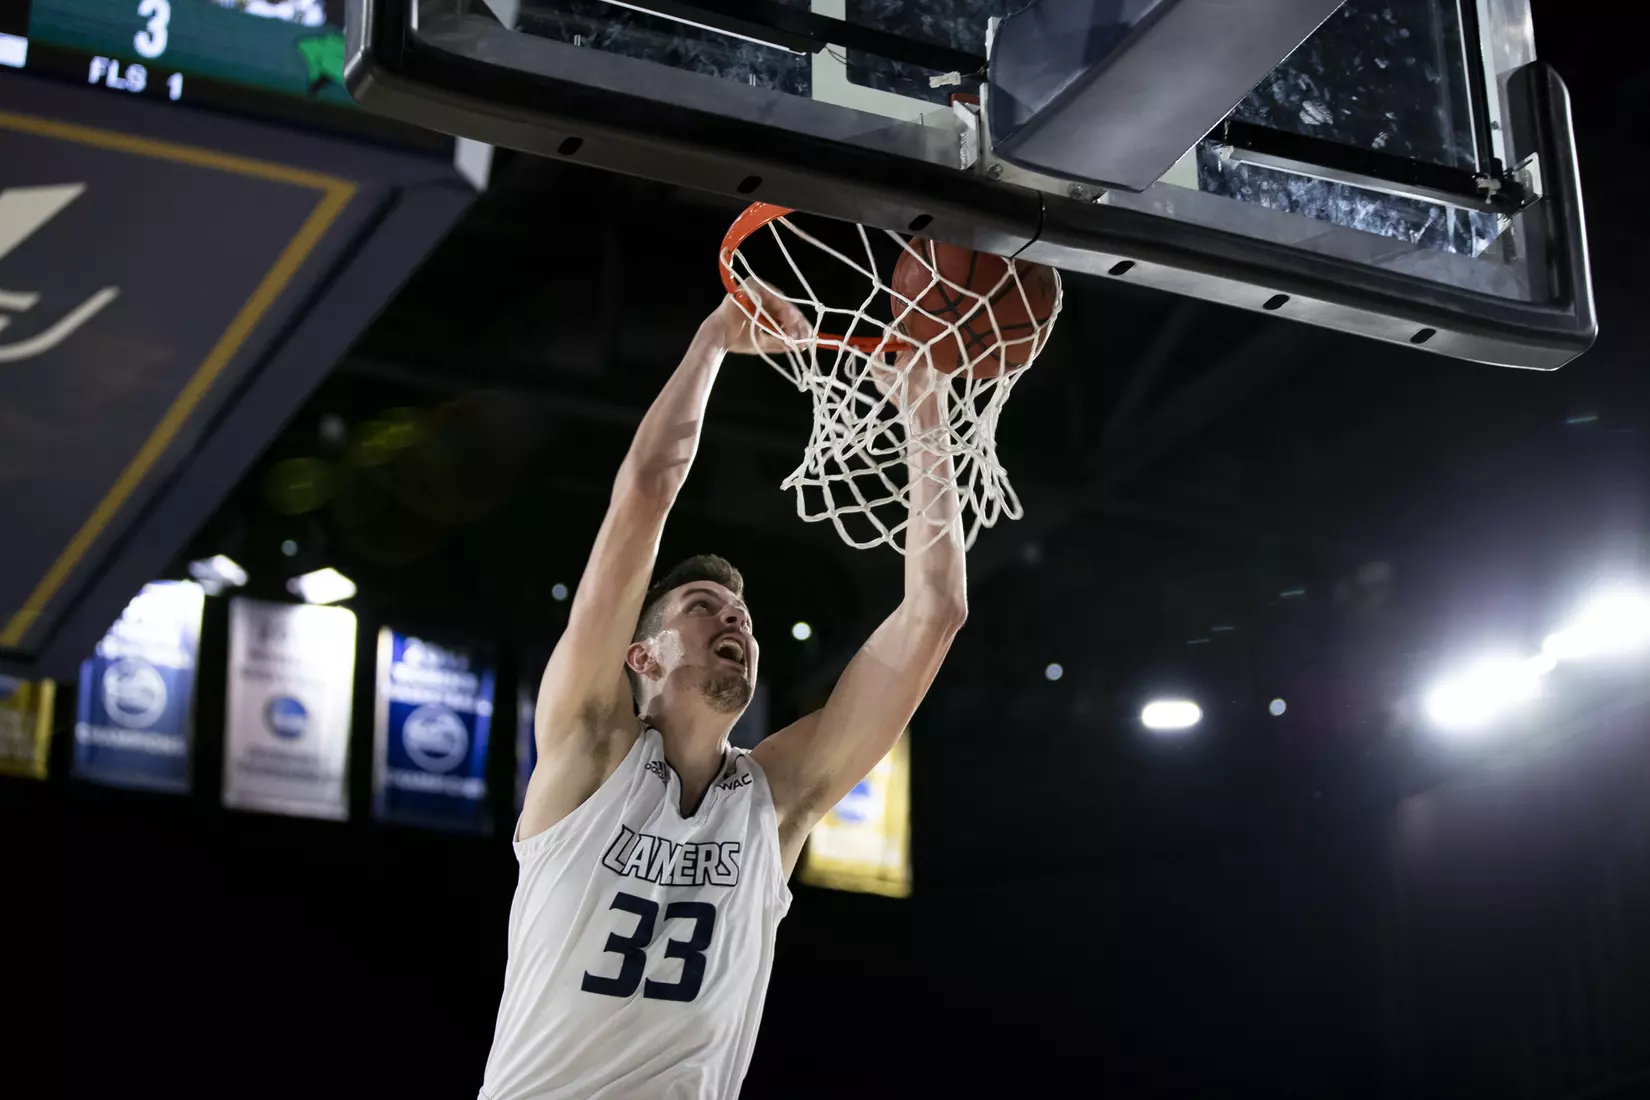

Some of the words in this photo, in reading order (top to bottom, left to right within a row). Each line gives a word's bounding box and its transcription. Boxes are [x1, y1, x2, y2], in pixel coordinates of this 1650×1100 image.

[134, 0, 171, 59] 3
[88, 55, 148, 93] FLS
[167, 72, 184, 101] 1
[718, 772, 752, 790] WAC
[602, 824, 740, 887] LANERS
[581, 892, 717, 1003] 33
